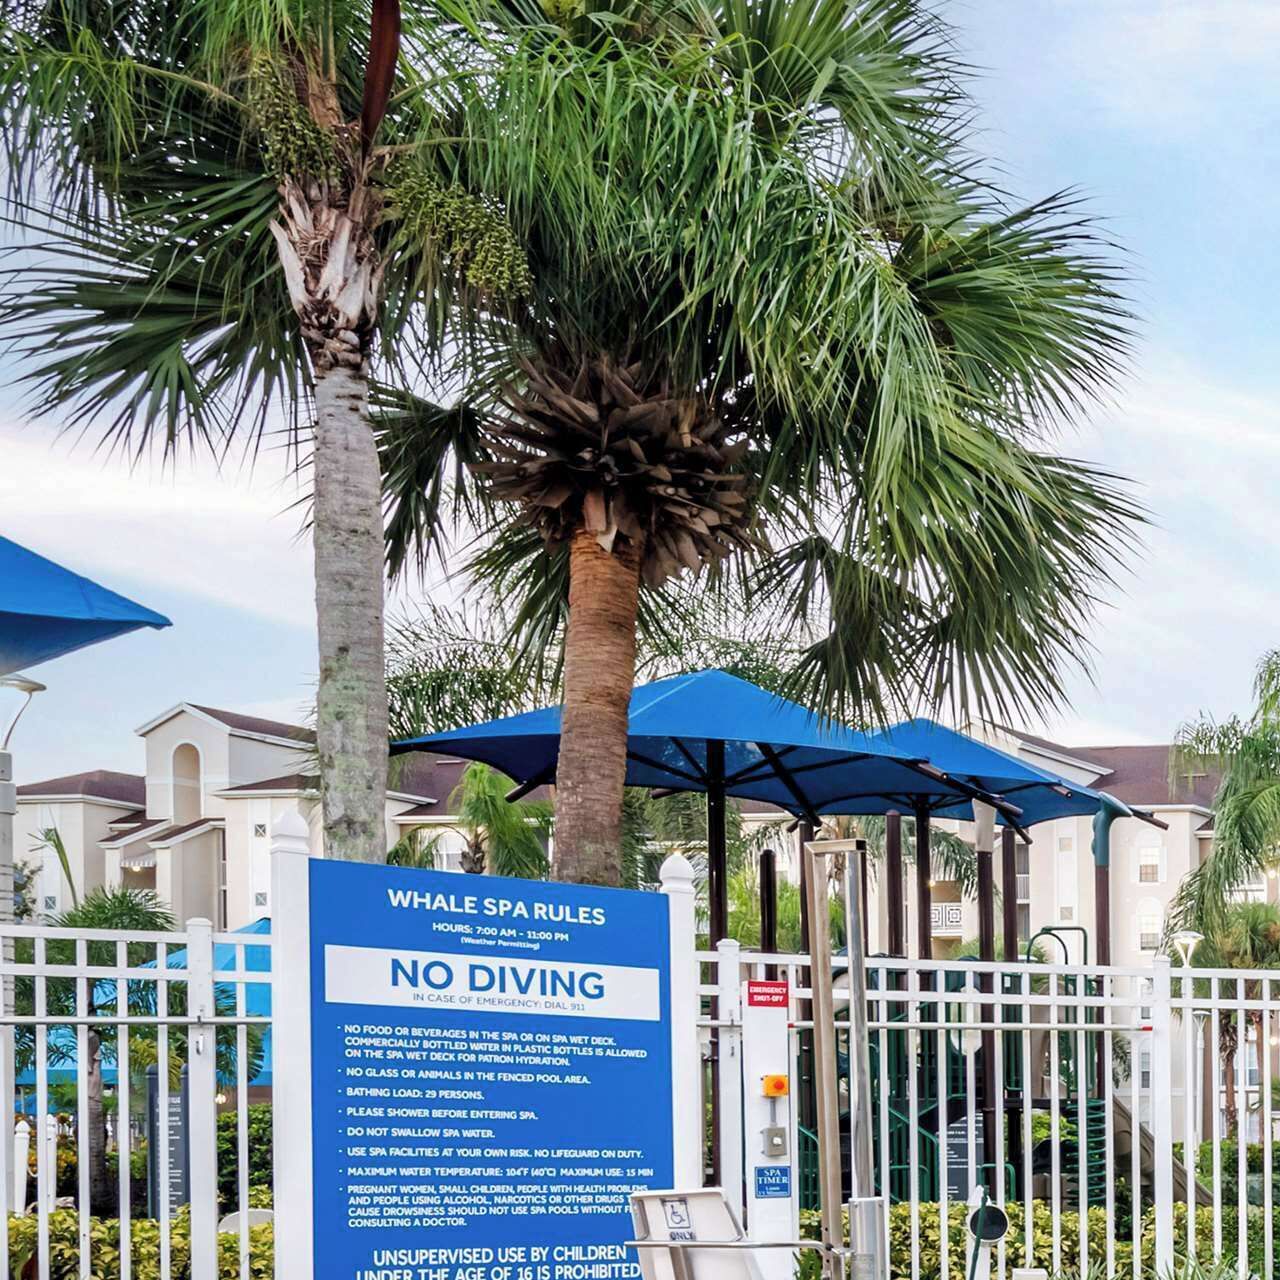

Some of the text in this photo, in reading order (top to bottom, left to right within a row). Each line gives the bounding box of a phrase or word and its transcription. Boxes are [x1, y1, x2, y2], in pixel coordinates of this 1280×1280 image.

[387, 889, 606, 925] WHALE SPA RULES
[432, 922, 473, 934] HOURS:
[476, 926, 498, 936] 7:00
[500, 928, 517, 937] AM
[527, 930, 553, 940] 11:00
[554, 932, 569, 941] PM
[460, 937, 541, 951] (Weather Permitting)
[391, 958, 605, 999] NO DIVING
[413, 992, 585, 1011] IN CASE OF EMERGENCY: DIAL 911
[344, 1024, 617, 1046] NO FOOD OR BEVERAGES IN THE SPA OR ON SPA WET DECK.
[345, 1036, 648, 1058] COMMERCIALLY BOTTLED WATER IN PLASTIC BOTTLES IS ALLOWED
[345, 1048, 571, 1066] ON THE SPA WET DECK FOR PATRON HYDRATION.
[346, 1067, 591, 1084] NO GLASS OR ANIMALS IN THE FENCED POOL AREA.
[346, 1087, 485, 1100] BATHING LOAD: 29 PERSONS.
[346, 1107, 539, 1120] PLEASE SHOWER BEFORE ENTERING SPA.
[347, 1127, 495, 1138] DO NOT SWALLOW SPA WATER.
[347, 1147, 644, 1159] USE SPA FACILITIES AT YOUR OWN RISK. NO LIFEGUARD ON DUTY.
[347, 1167, 654, 1177] MAXIMUM WATER TEMPERATURE: MAXIMUM USE: 15 MIN
[764, 1169, 782, 1177] SPA
[758, 1176, 789, 1184] TIMER
[347, 1185, 606, 1195] PREGNANT WOMEN, SMALL CHILDREN, PEOPLE WITH HEALTH
[348, 1196, 371, 1205] AND
[373, 1196, 410, 1205] PEOPLE
[412, 1196, 441, 1205] USING
[442, 1196, 492, 1206] ALCOHOL,
[494, 1195, 547, 1204] NARCOTICS
[548, 1195, 563, 1204] OR
[563, 1195, 594, 1204] OTHER
[595, 1195, 625, 1204] DRUGS
[348, 1207, 381, 1217] CAUSE
[383, 1207, 446, 1216] DROWSINESS
[447, 1206, 487, 1216] SHOULD
[489, 1206, 508, 1215] NOT
[511, 1206, 529, 1215] USE
[530, 1206, 547, 1215] SPA
[548, 1205, 579, 1215] POOLS
[580, 1205, 624, 1214] WITHOUT
[348, 1217, 467, 1228] CONSULTING A DOCTOR.
[373, 1245, 627, 1266] UNSUPERVISED USE BY CHILDREN
[537, 1265, 550, 1280] IS
[555, 1263, 640, 1280] PROHIBITED
